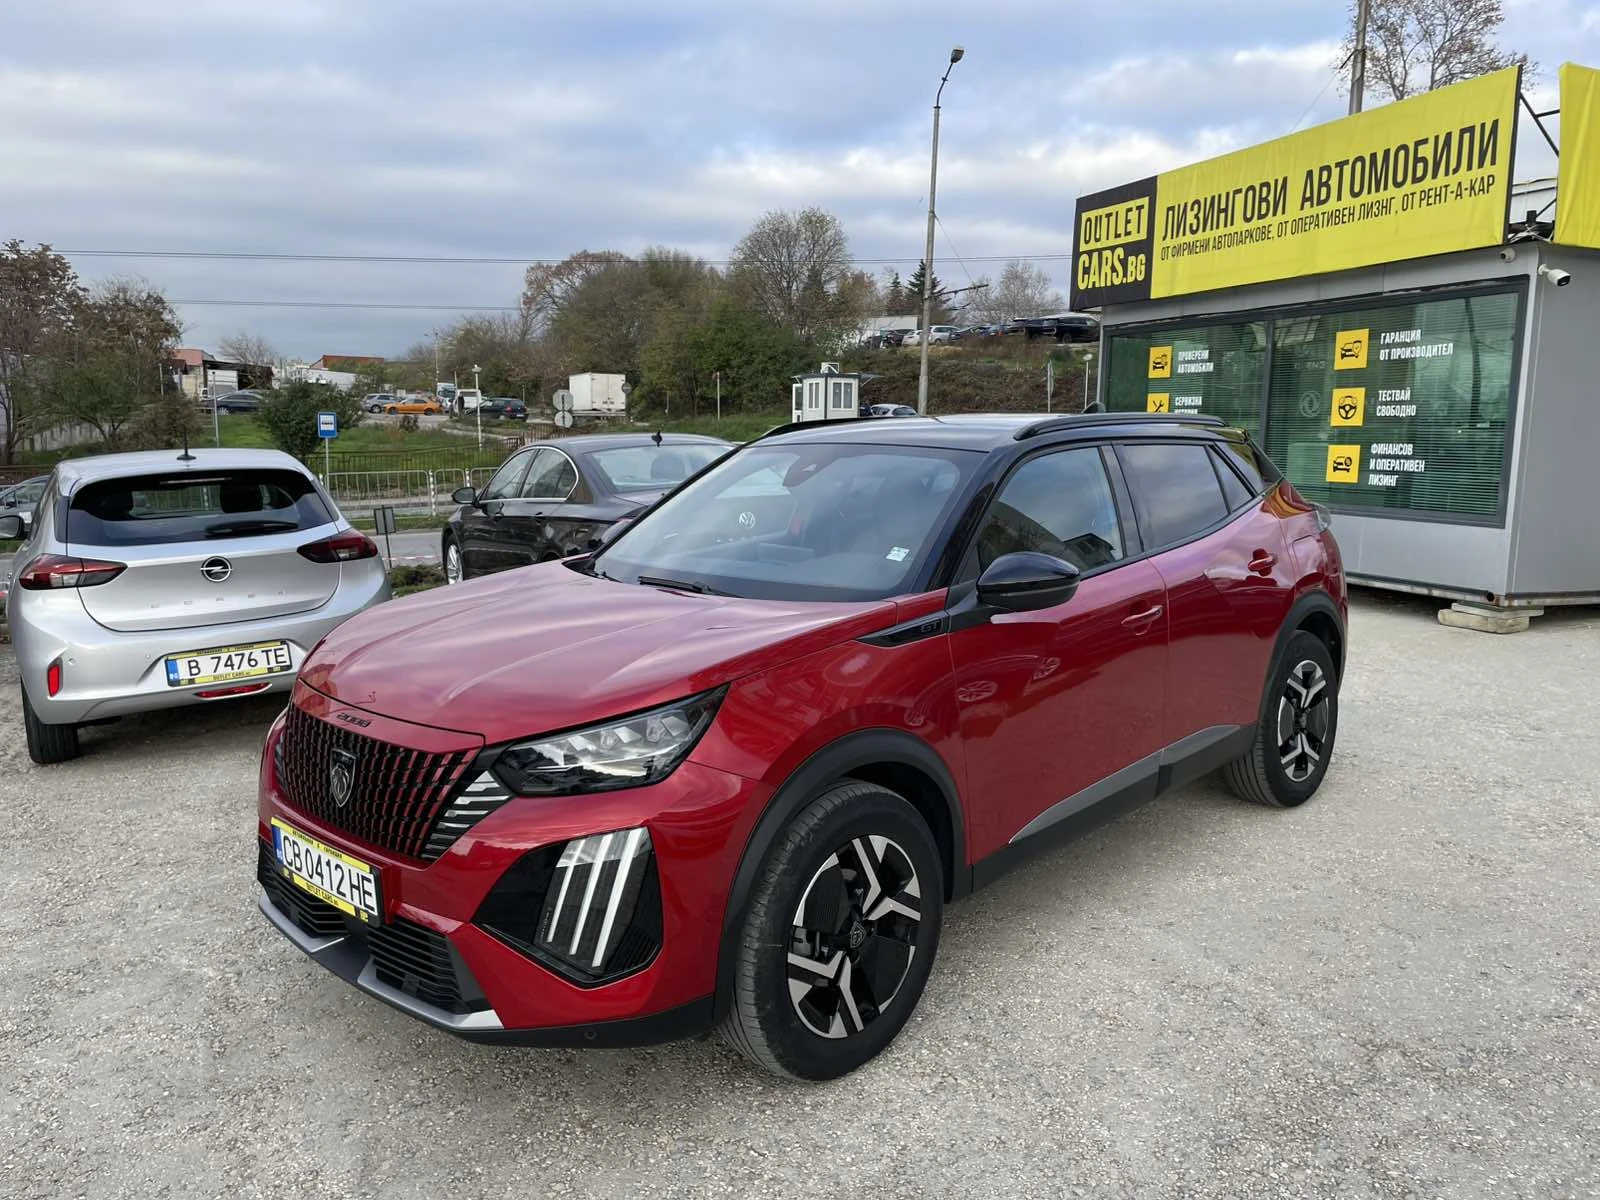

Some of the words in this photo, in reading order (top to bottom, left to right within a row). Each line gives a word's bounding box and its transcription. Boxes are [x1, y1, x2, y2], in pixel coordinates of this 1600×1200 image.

[1162, 176, 1288, 241] ЛИЗИНГОВИ
[1300, 118, 1499, 210] АВТОМОБИЛИ
[1084, 204, 1145, 245] OUTLET
[1160, 245, 1171, 261] ОТ
[1171, 237, 1210, 258] ФИРМЕНИ
[1212, 224, 1275, 251] АВТОПАРКОВЕ,
[1277, 220, 1290, 238] ОТ
[1290, 205, 1355, 236] ОПЕРАТИВЕН
[1401, 191, 1417, 212] ОТ
[1418, 174, 1496, 208] РЕНТ-А-КАР
[1077, 246, 1146, 291] CARS.BG
[1380, 329, 1422, 345] ГАРАНЦИЯ
[1379, 348, 1390, 361] ОТ
[1390, 342, 1454, 360] ПРОИЗВОДИТЕЛ
[1378, 387, 1411, 402] ТЕСТВАЙ
[1376, 404, 1417, 418] СВОБОДНО
[1370, 442, 1413, 456] ФИНАНСОВ
[1369, 458, 1376, 470] И
[1376, 458, 1425, 473] ОПЕРАТИВЕН
[1368, 474, 1399, 487] ЛИЗИНГ
[187, 659, 201, 676] B
[210, 651, 259, 673] 7476
[261, 647, 288, 665] TE
